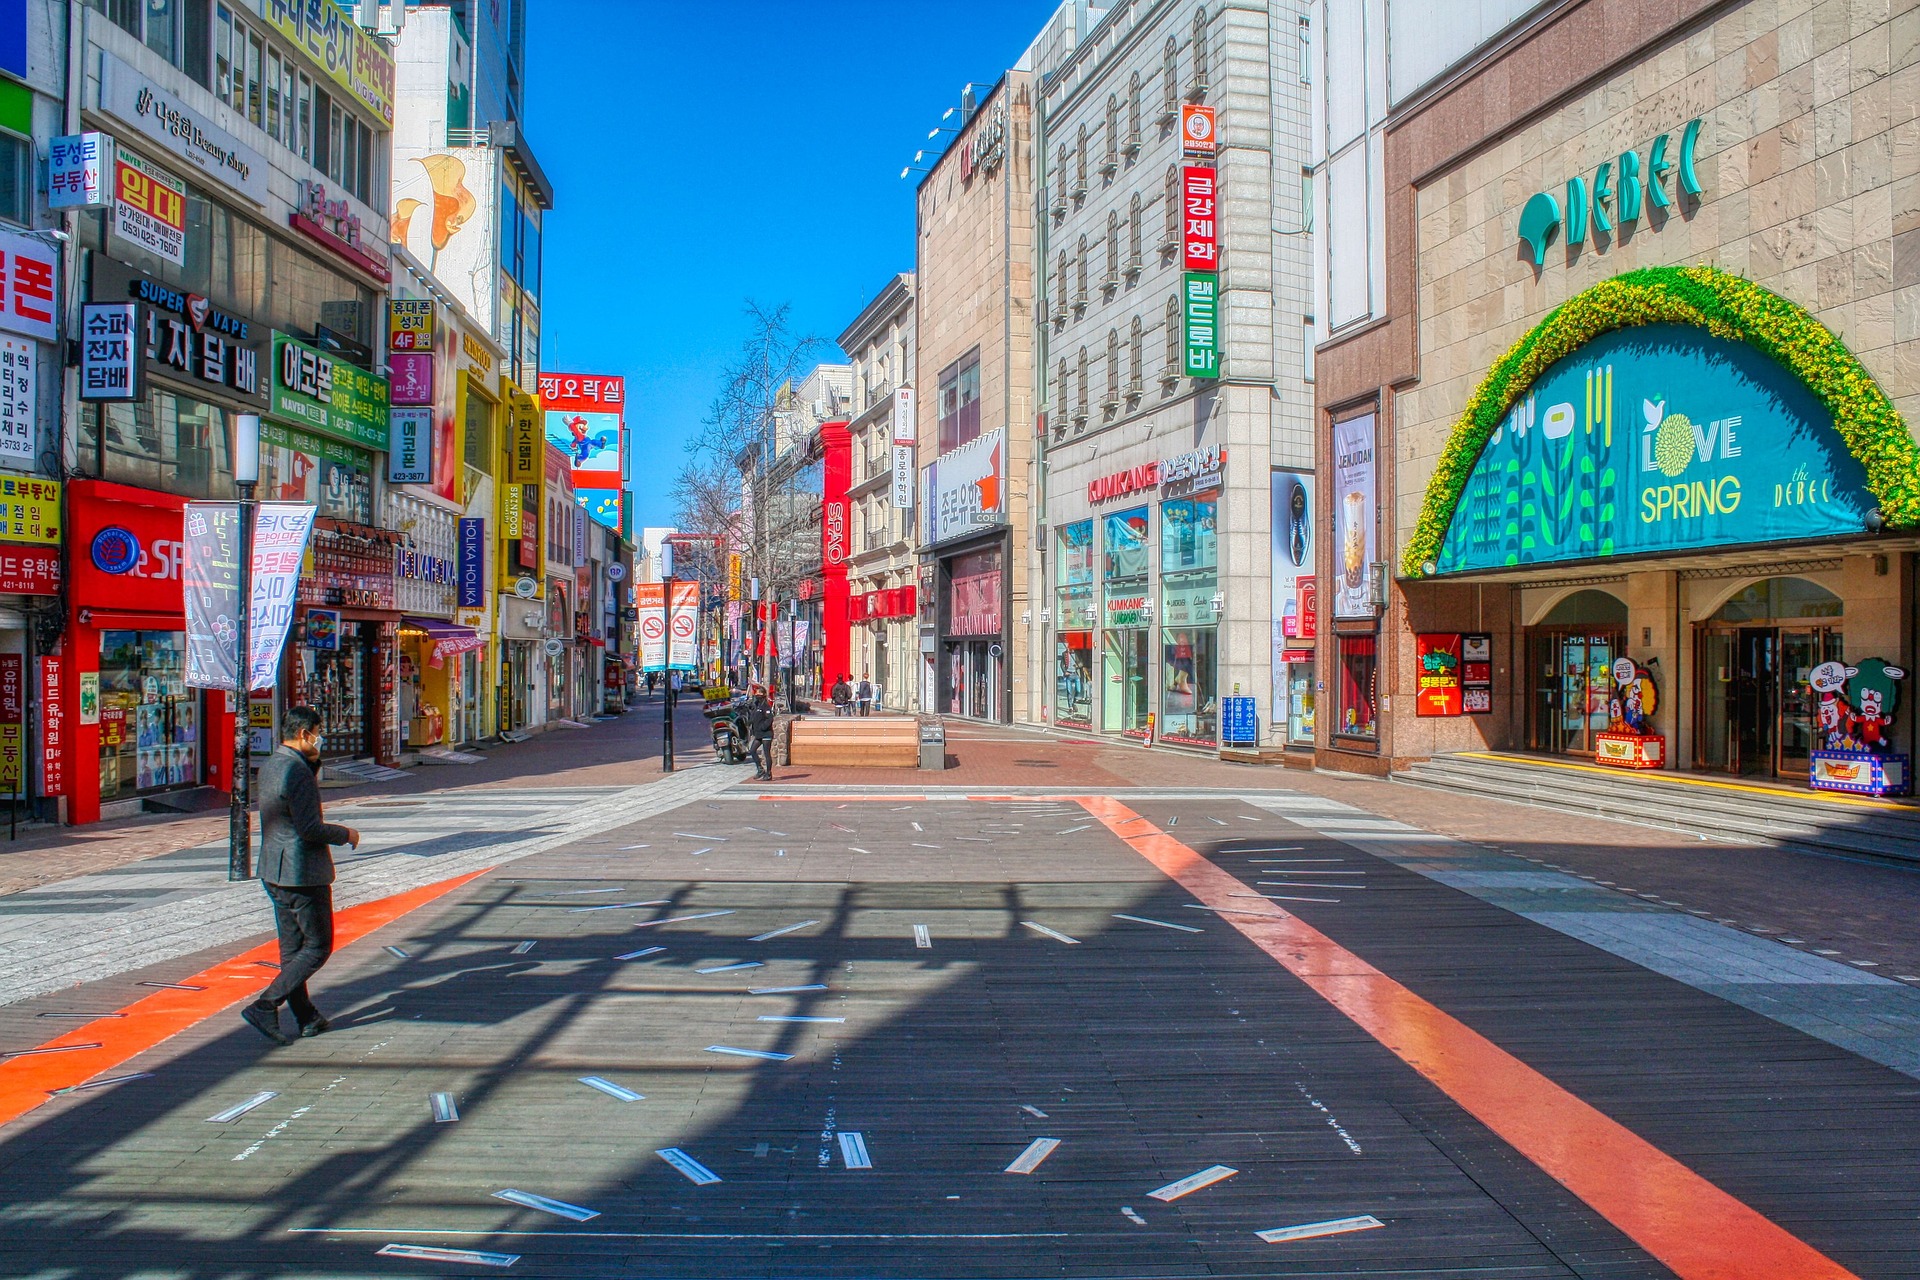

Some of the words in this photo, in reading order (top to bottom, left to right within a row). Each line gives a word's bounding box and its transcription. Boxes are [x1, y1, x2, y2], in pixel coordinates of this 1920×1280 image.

[52, 141, 97, 166] 동성로
[119, 150, 142, 169] NAVER
[154, 102, 192, 146] 나영희
[194, 127, 227, 166] Beauty
[228, 149, 250, 181] shop
[52, 169, 97, 194] 부동산
[87, 192, 99, 202] 3F
[1566, 118, 1703, 246] DEBEC
[1187, 176, 1216, 260] 금강제화
[122, 220, 140, 239] 053)
[141, 229, 178, 257] 425-7600
[88, 313, 129, 335] 슈퍼
[139, 280, 184, 313] SUPER
[213, 310, 249, 340] VAPE
[393, 302, 431, 315] 휴대폰
[400, 316, 424, 329] 성지
[1188, 280, 1215, 370] 랜드로바
[88, 340, 130, 362] 전자
[394, 332, 413, 347] 4F
[88, 366, 129, 389] 담배
[284, 342, 333, 403] 에코폰
[332, 364, 354, 391] 중고폰
[17, 354, 30, 438] 액정수리
[281, 397, 307, 417] NAVER
[403, 421, 417, 469] 에코폰
[519, 419, 532, 472] 한스델리
[1338, 448, 1372, 469] JENJUDAN
[1641, 413, 1742, 478] LOVE
[0, 479, 57, 501] 로부동산
[393, 472, 425, 481] 423-3877
[897, 449, 908, 505] 종로유학원
[1088, 461, 1160, 502] KUMKANG
[1791, 462, 1809, 482] the
[509, 486, 518, 536] SKINFOOD
[1641, 475, 1742, 523] SPRING
[1774, 478, 1829, 508] DEBEC
[466, 519, 477, 562] HOLIKA
[828, 502, 844, 565] SPAO
[3, 581, 35, 590] 421-8118
[22, 558, 60, 580] 유학원
[466, 563, 477, 606] HOLIKA
[3, 670, 18, 711] 유학원
[46, 660, 60, 700] 뉴월드
[46, 703, 60, 746] 유학원
[2, 726, 20, 783] 부동산
